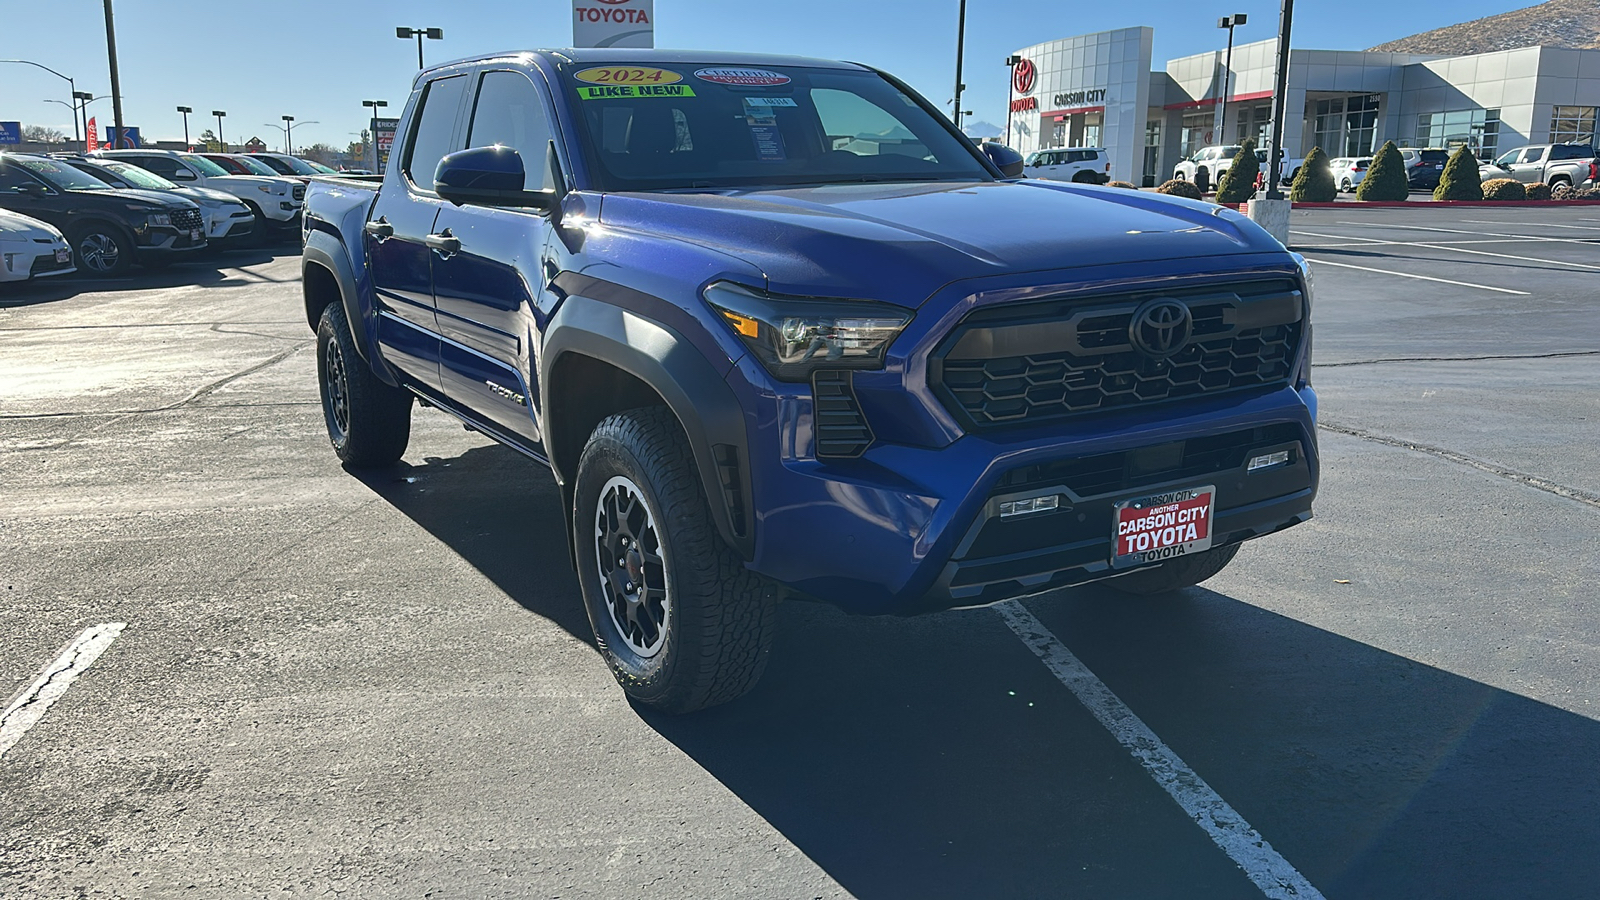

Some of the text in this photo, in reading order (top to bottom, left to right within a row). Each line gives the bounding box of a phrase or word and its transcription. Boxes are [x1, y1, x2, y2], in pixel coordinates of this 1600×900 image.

[576, 8, 649, 23] TOYOTA
[594, 69, 663, 82] 2024
[703, 69, 778, 78] CERTIFIED
[588, 85, 684, 97] LIKE NEW
[1054, 88, 1106, 106] CARSON CITY
[1011, 96, 1036, 112] TOYOTA
[485, 380, 525, 405] TACOMA
[1141, 490, 1194, 506] CARSON CITY
[1149, 504, 1179, 516] ANOTHER
[1118, 505, 1209, 536] CARSON CITY
[1126, 522, 1198, 553] TOYOTA
[1141, 544, 1185, 562] TOYOTA
